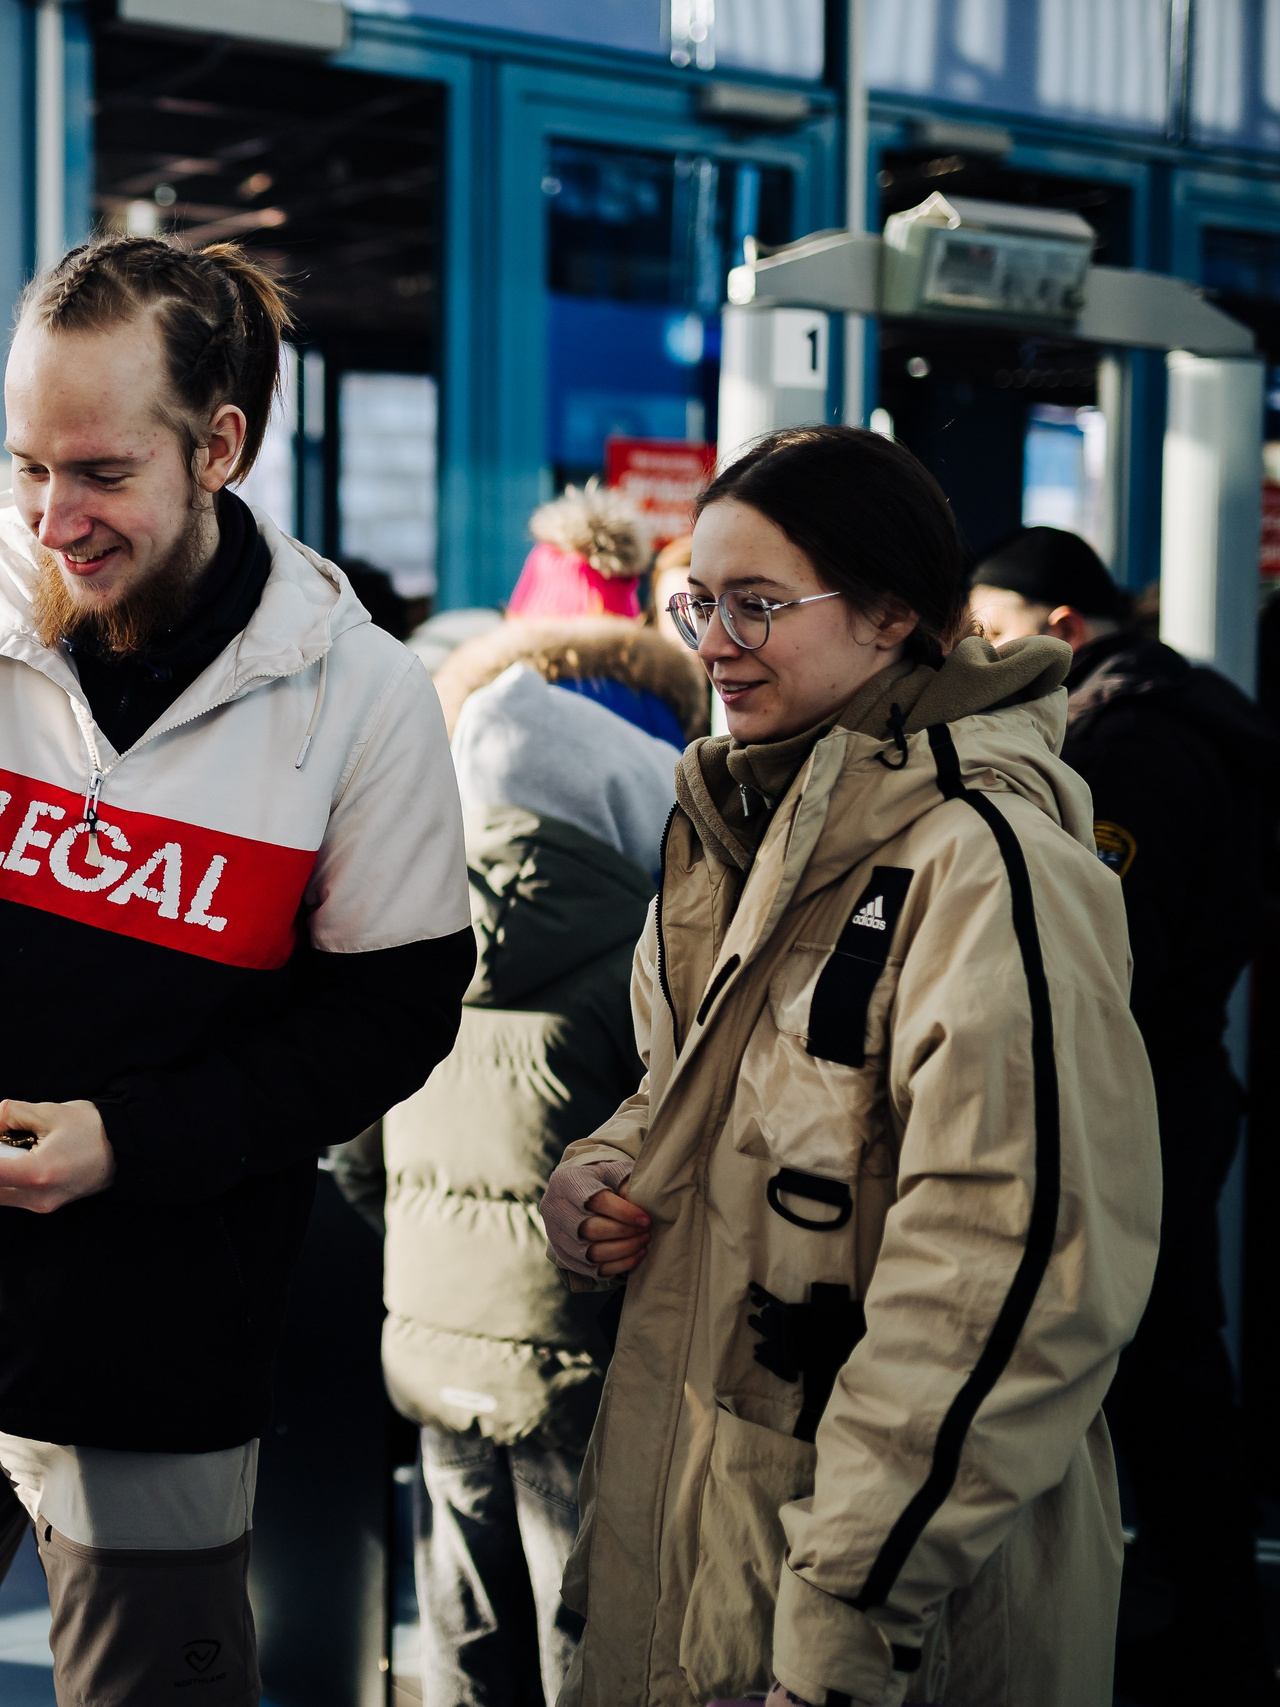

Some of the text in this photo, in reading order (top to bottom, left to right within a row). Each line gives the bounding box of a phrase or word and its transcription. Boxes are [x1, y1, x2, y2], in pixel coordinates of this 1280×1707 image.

[806, 329, 818, 371] 1
[852, 914, 886, 931] adidas
[174, 1671, 227, 1688] NORTHLAND
